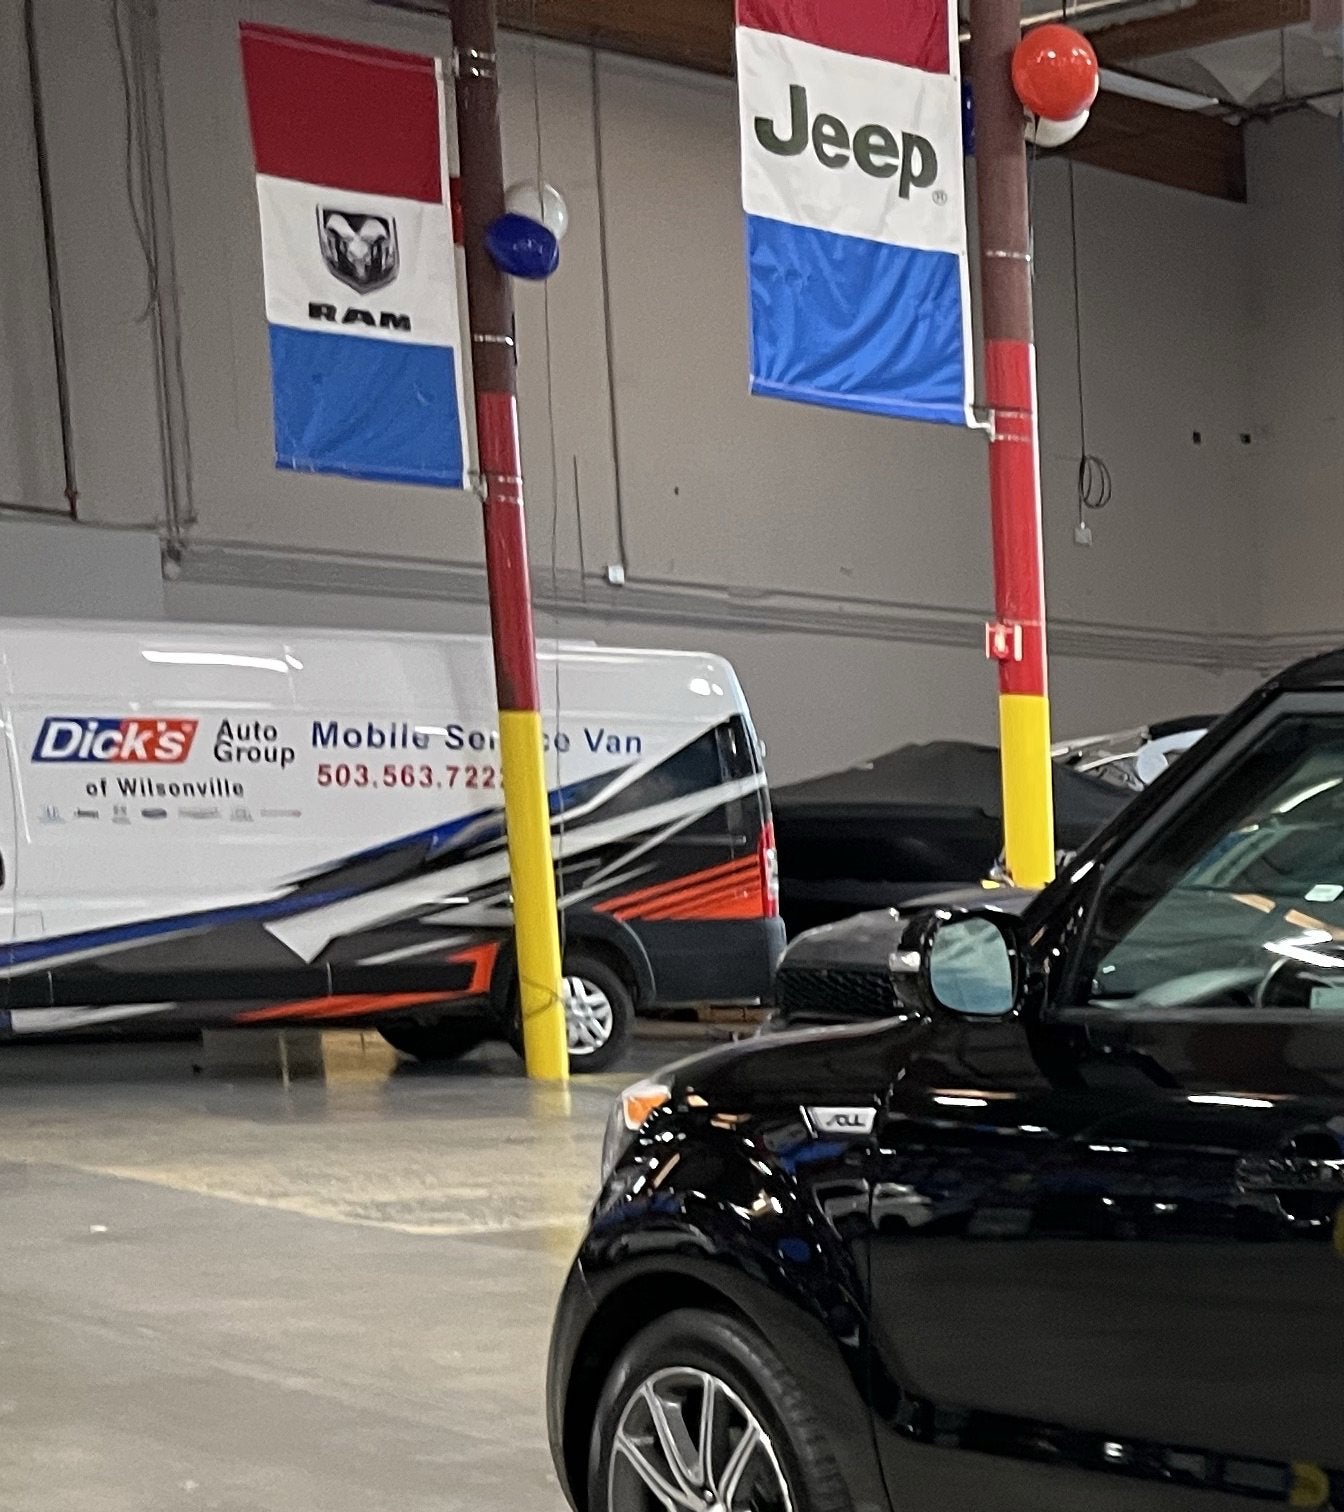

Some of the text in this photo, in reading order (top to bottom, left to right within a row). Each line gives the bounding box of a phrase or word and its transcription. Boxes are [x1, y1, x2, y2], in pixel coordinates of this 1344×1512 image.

[754, 84, 938, 200] Jeep
[308, 302, 411, 332] RAM
[40, 717, 277, 760] Dick's Auto
[312, 721, 430, 750] Mobile
[584, 728, 642, 754] Van
[214, 740, 295, 769] Group
[86, 777, 244, 798] of Wilsonville
[317, 764, 504, 789] 503.563.722
